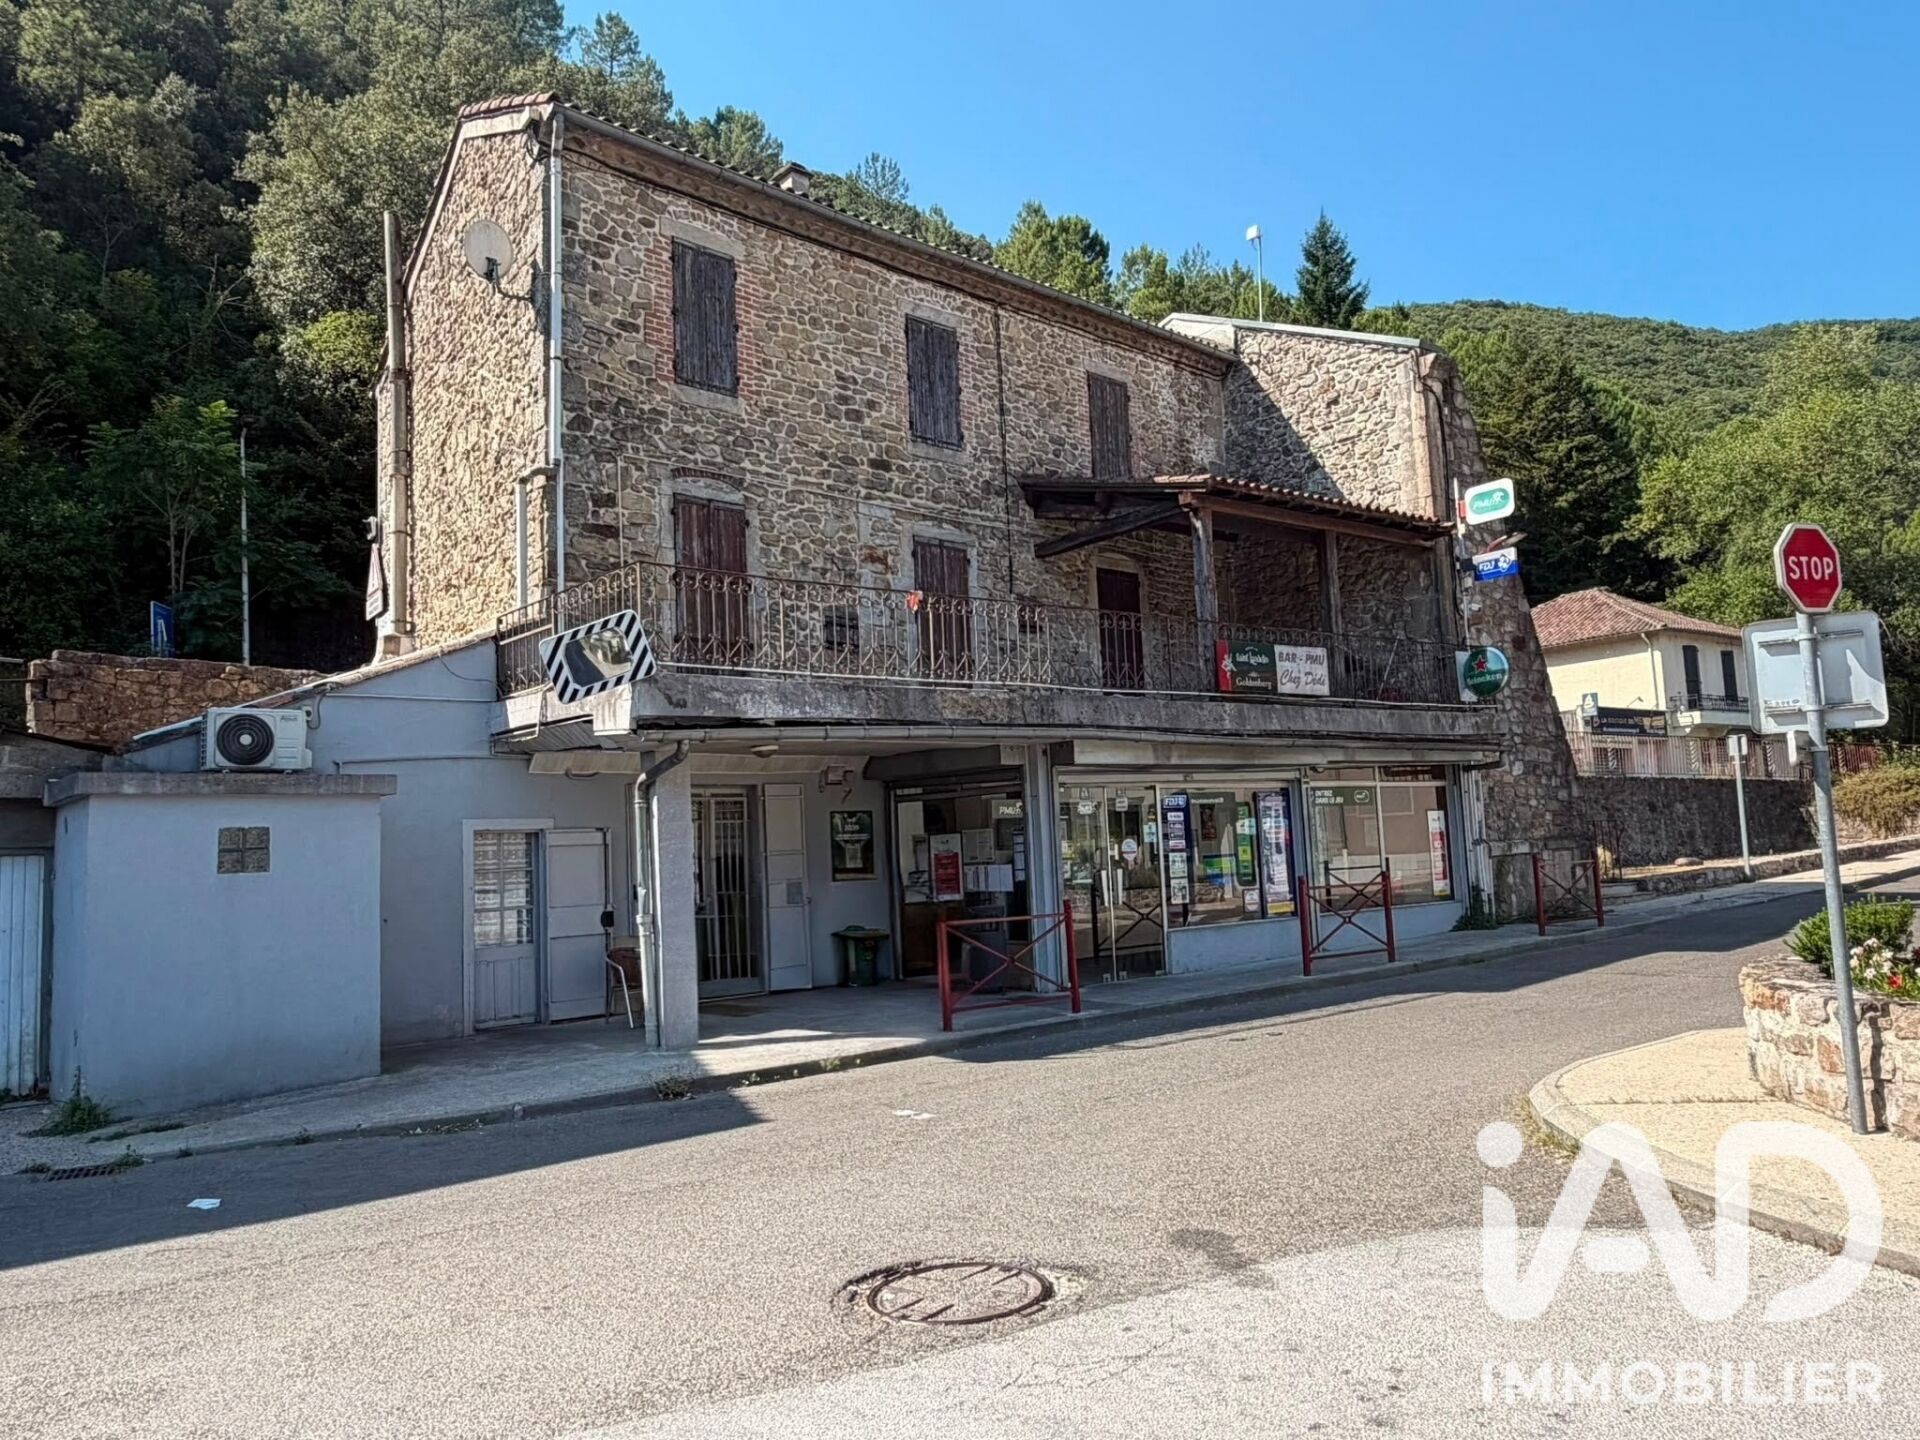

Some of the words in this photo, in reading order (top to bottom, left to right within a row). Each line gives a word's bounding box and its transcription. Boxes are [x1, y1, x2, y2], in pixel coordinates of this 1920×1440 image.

[1479, 560, 1495, 572] FDJ
[1788, 555, 1833, 580] STOP
[1278, 652, 1297, 664] BAR
[1305, 654, 1325, 667] PMU
[1280, 669, 1302, 689] Chez
[1165, 798, 1178, 806] FDJ
